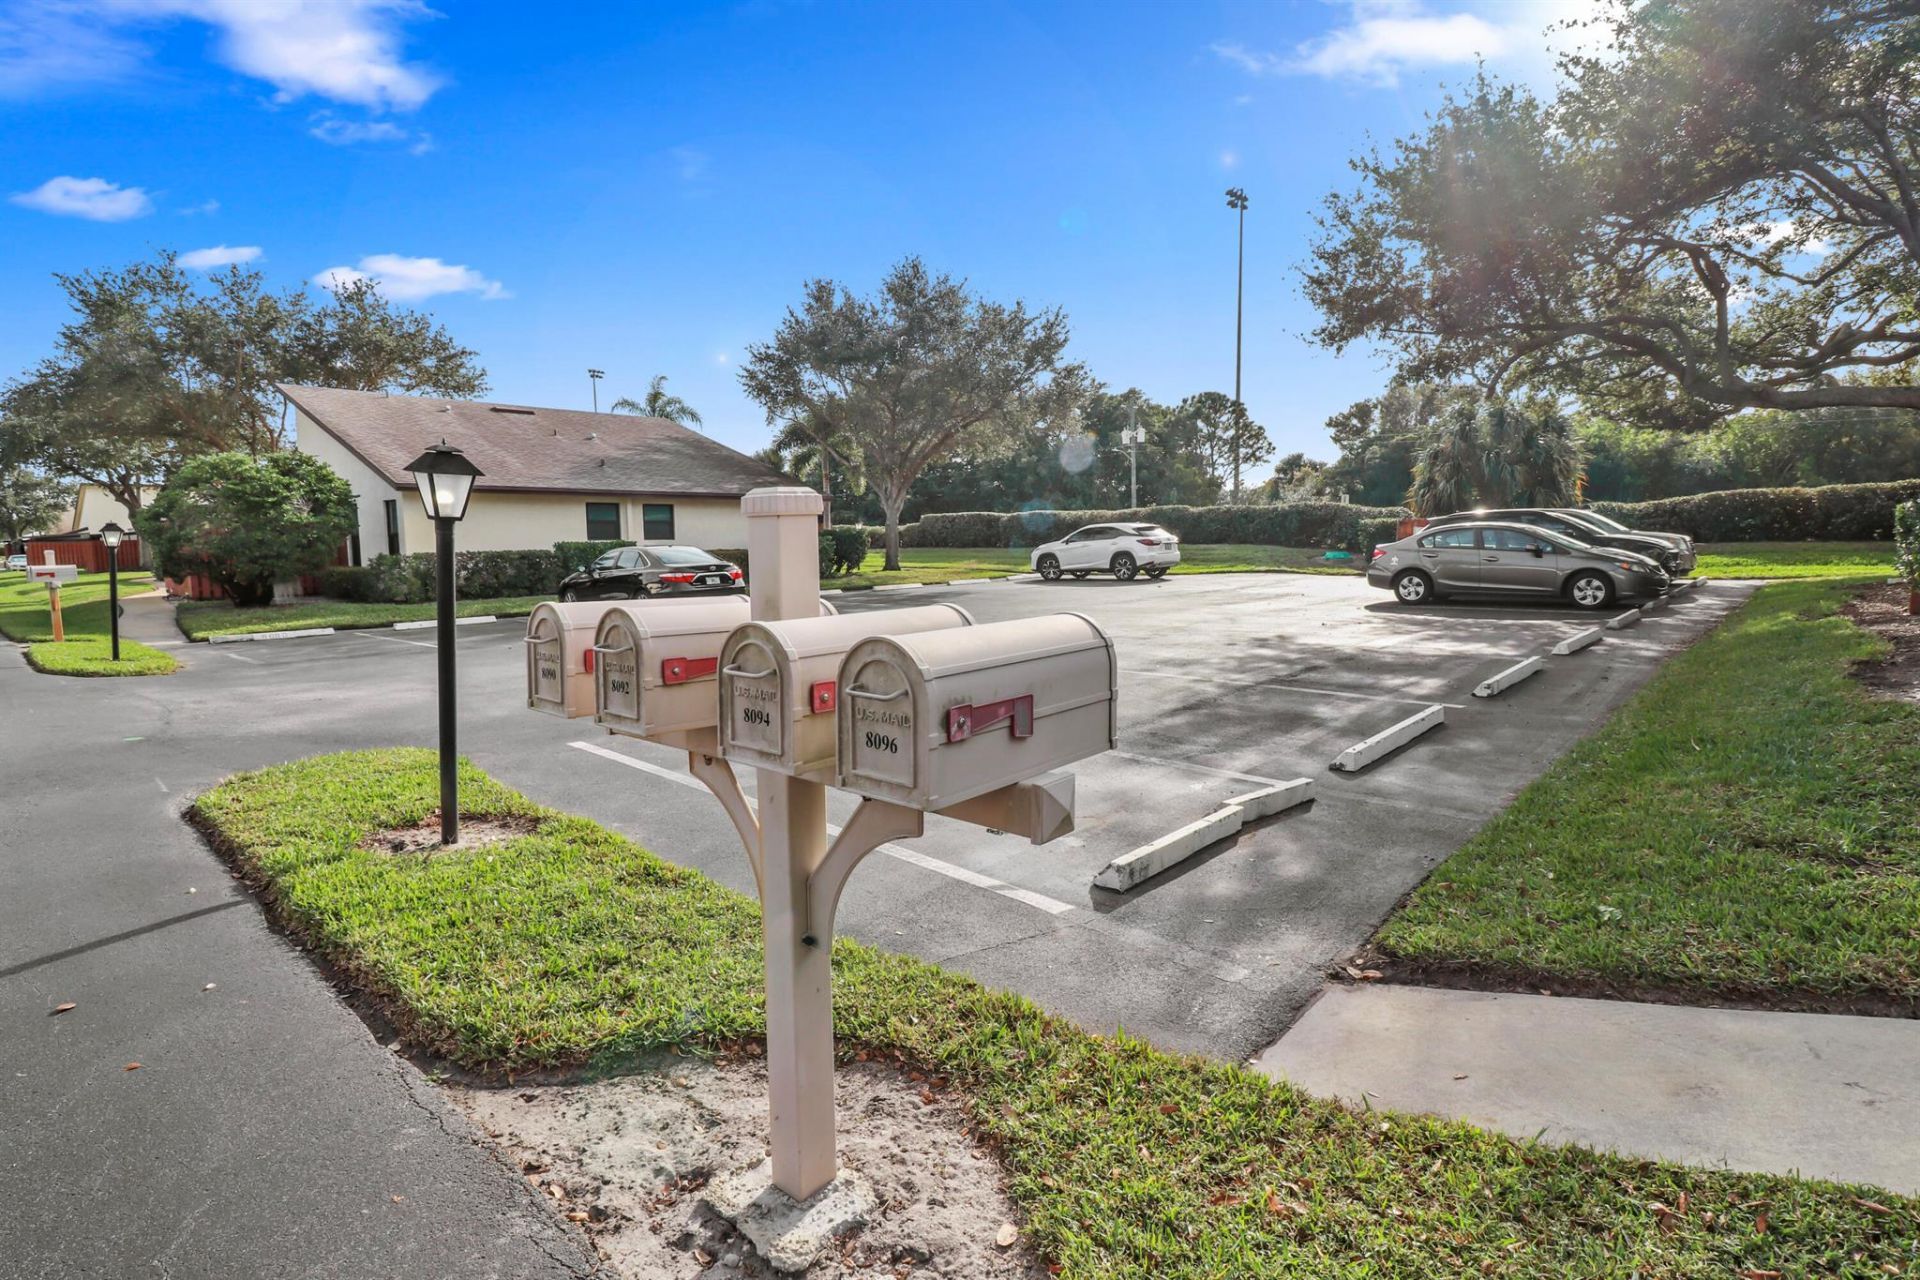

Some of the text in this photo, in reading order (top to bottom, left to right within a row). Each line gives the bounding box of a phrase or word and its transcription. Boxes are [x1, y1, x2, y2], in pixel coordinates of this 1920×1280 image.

[611, 679, 630, 695] 8092
[743, 707, 770, 727] 8094
[881, 711, 912, 728] MAIL
[865, 731, 898, 754] 8096
